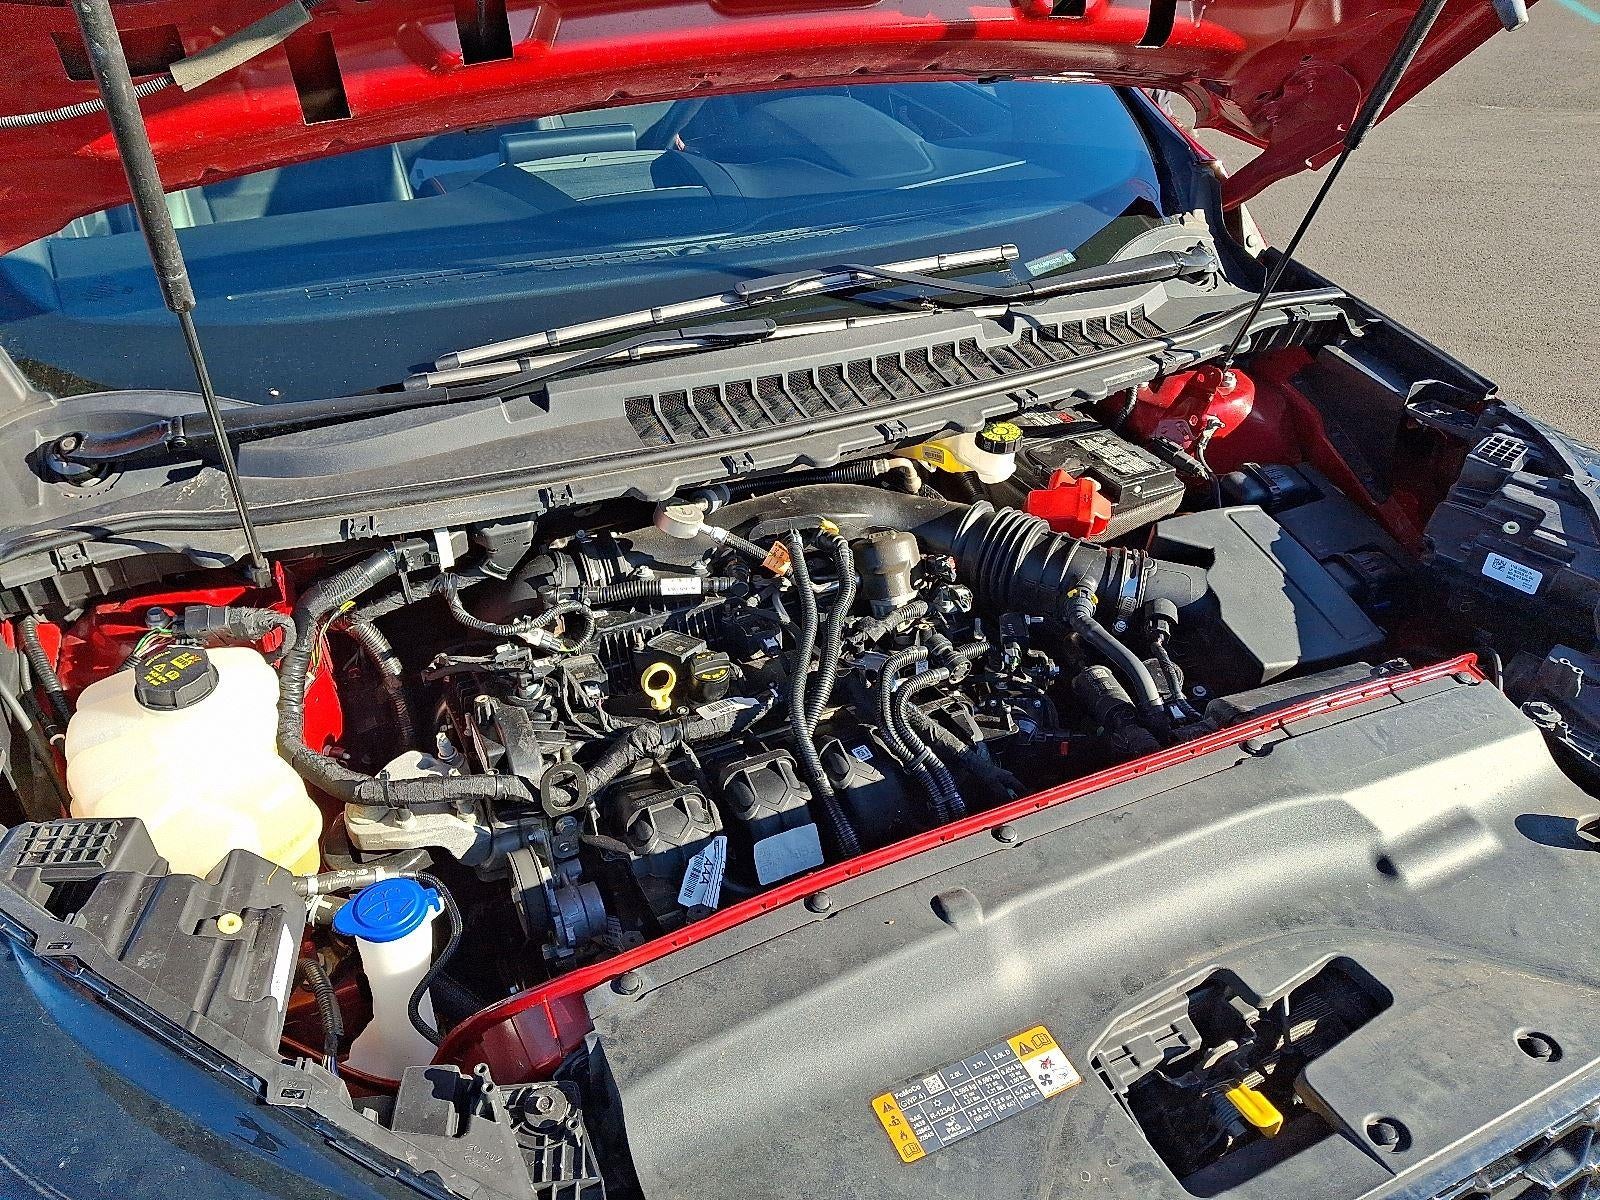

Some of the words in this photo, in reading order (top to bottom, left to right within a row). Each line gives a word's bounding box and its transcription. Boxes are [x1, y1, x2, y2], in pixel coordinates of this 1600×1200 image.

[700, 856, 713, 884] AAA
[894, 1083, 922, 1100] FoMoCo
[898, 1095, 919, 1110] (GWP
[929, 1103, 957, 1121] R-1234yf
